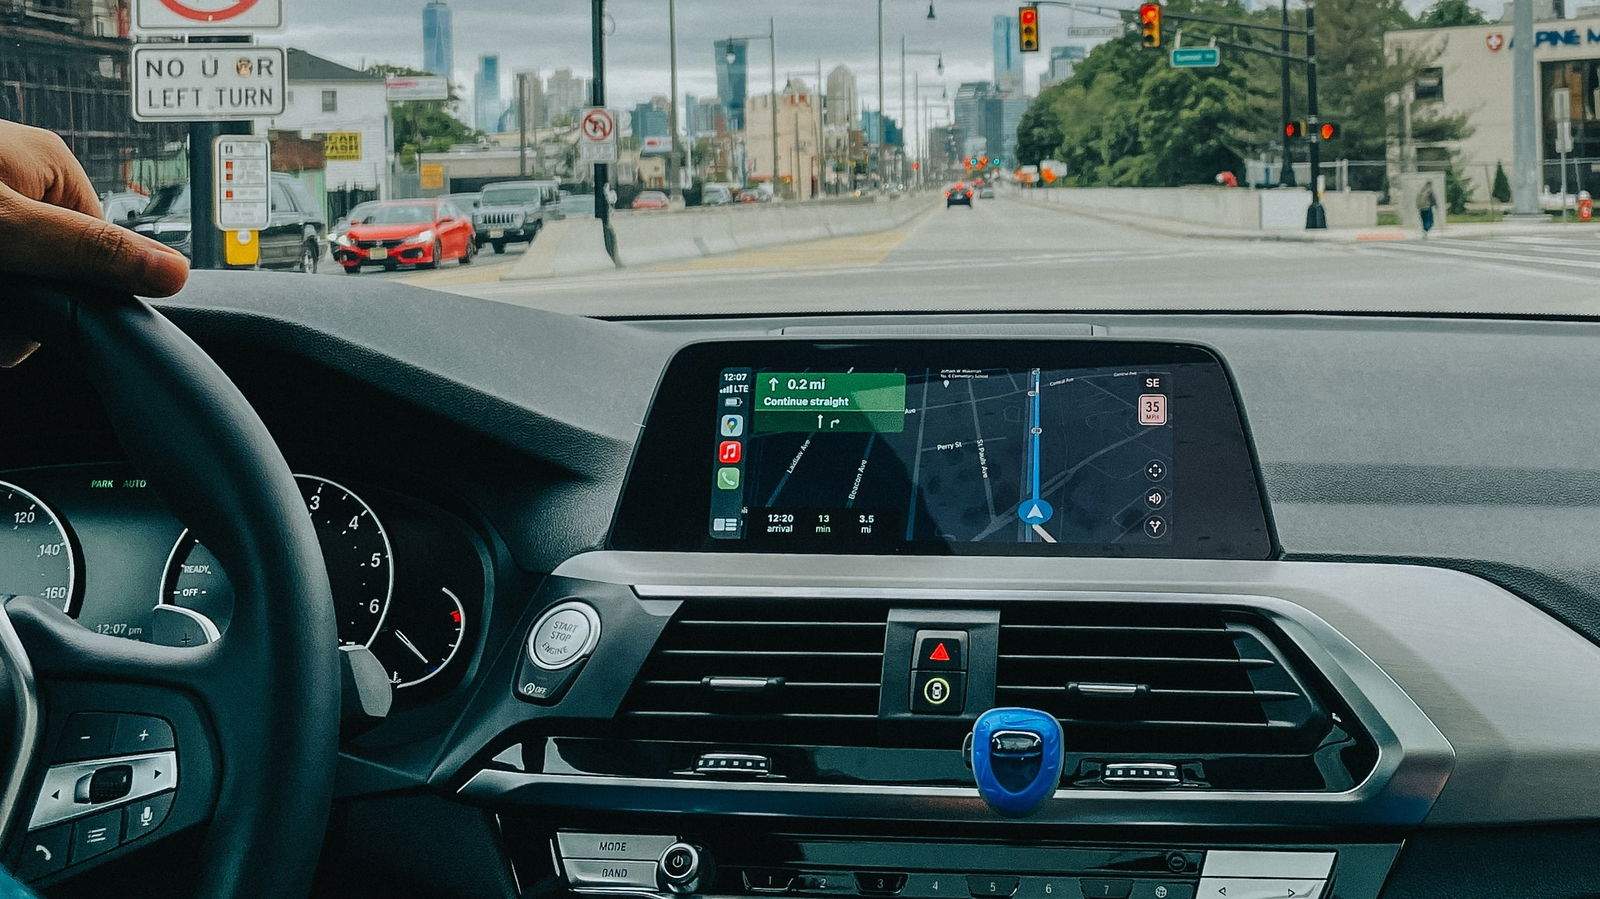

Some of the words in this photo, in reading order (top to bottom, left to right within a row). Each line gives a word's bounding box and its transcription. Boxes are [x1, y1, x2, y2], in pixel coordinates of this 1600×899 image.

[1508, 28, 1580, 48] PINE
[146, 59, 184, 78] NO
[201, 59, 218, 78] U
[148, 88, 202, 108] LEFT
[215, 88, 272, 107] TURN
[788, 379, 807, 390] 0.2
[810, 379, 825, 390] mi
[1146, 378, 1160, 388] SE
[734, 385, 749, 393] LTE
[764, 396, 808, 406] Continue
[810, 397, 849, 407] straight
[1146, 401, 1160, 413] 35
[977, 439, 984, 447] St
[787, 451, 803, 474] Laidlaw
[801, 439, 811, 451] Ave
[979, 447, 987, 466] Pauls
[91, 480, 114, 488] PARK
[123, 480, 147, 488] AUTO
[848, 473, 863, 500] Beacon
[858, 459, 868, 473] Ave
[310, 495, 320, 510] 3
[14, 512, 35, 524] 120
[349, 515, 359, 530] 4
[768, 514, 794, 523] 12:20
[818, 515, 830, 523] 13
[859, 515, 874, 523] 3.5
[767, 525, 793, 533] arrival
[816, 525, 831, 533] min
[861, 525, 872, 533] mi
[39, 544, 60, 556] 140
[370, 553, 381, 568] 5
[184, 565, 209, 574] READY
[45, 587, 67, 599] 160
[183, 588, 199, 596] OFF
[369, 598, 380, 614] 6
[97, 624, 127, 634] 12:07
[128, 626, 142, 635] pm
[553, 621, 578, 633] START
[550, 631, 572, 642] STOP
[542, 641, 568, 655] ENGINE
[599, 842, 627, 852] MODE
[602, 869, 628, 878] BAND
[768, 876, 772, 885] 1
[820, 879, 826, 889] 2
[877, 879, 884, 889] 3
[932, 880, 939, 890] 4
[990, 882, 996, 892] 5
[1045, 884, 1052, 894] 6
[1104, 885, 1110, 895] 7
